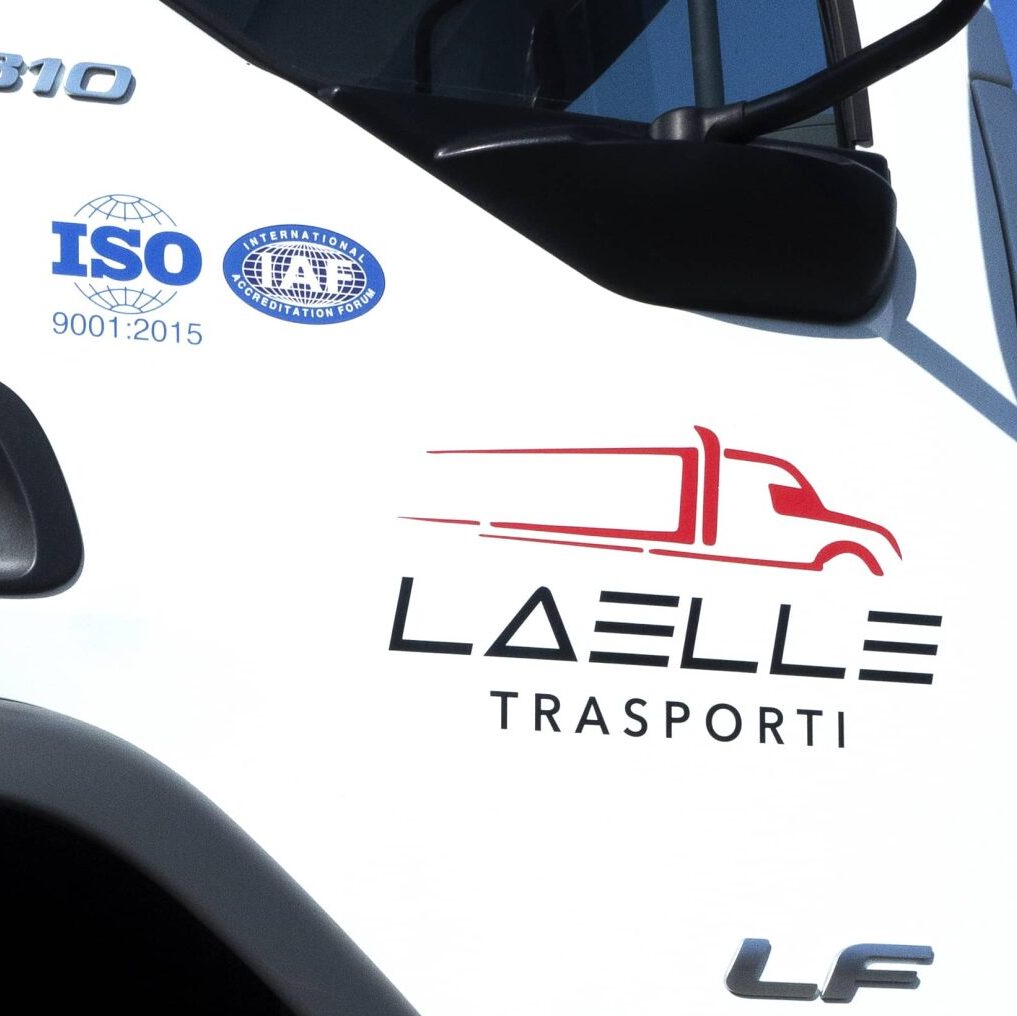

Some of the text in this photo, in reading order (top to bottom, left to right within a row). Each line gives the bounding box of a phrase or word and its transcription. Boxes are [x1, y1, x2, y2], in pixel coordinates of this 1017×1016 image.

[51, 220, 203, 286] ISO
[242, 229, 366, 264] INTERNATIONAL
[260, 252, 354, 294] IAF
[231, 273, 377, 319] ACCREDITATION FORUM
[52, 311, 203, 346] 9001:2015
[388, 575, 944, 685] LAELLE
[489, 689, 846, 749] TRASPORTI
[723, 936, 935, 1005] LF
